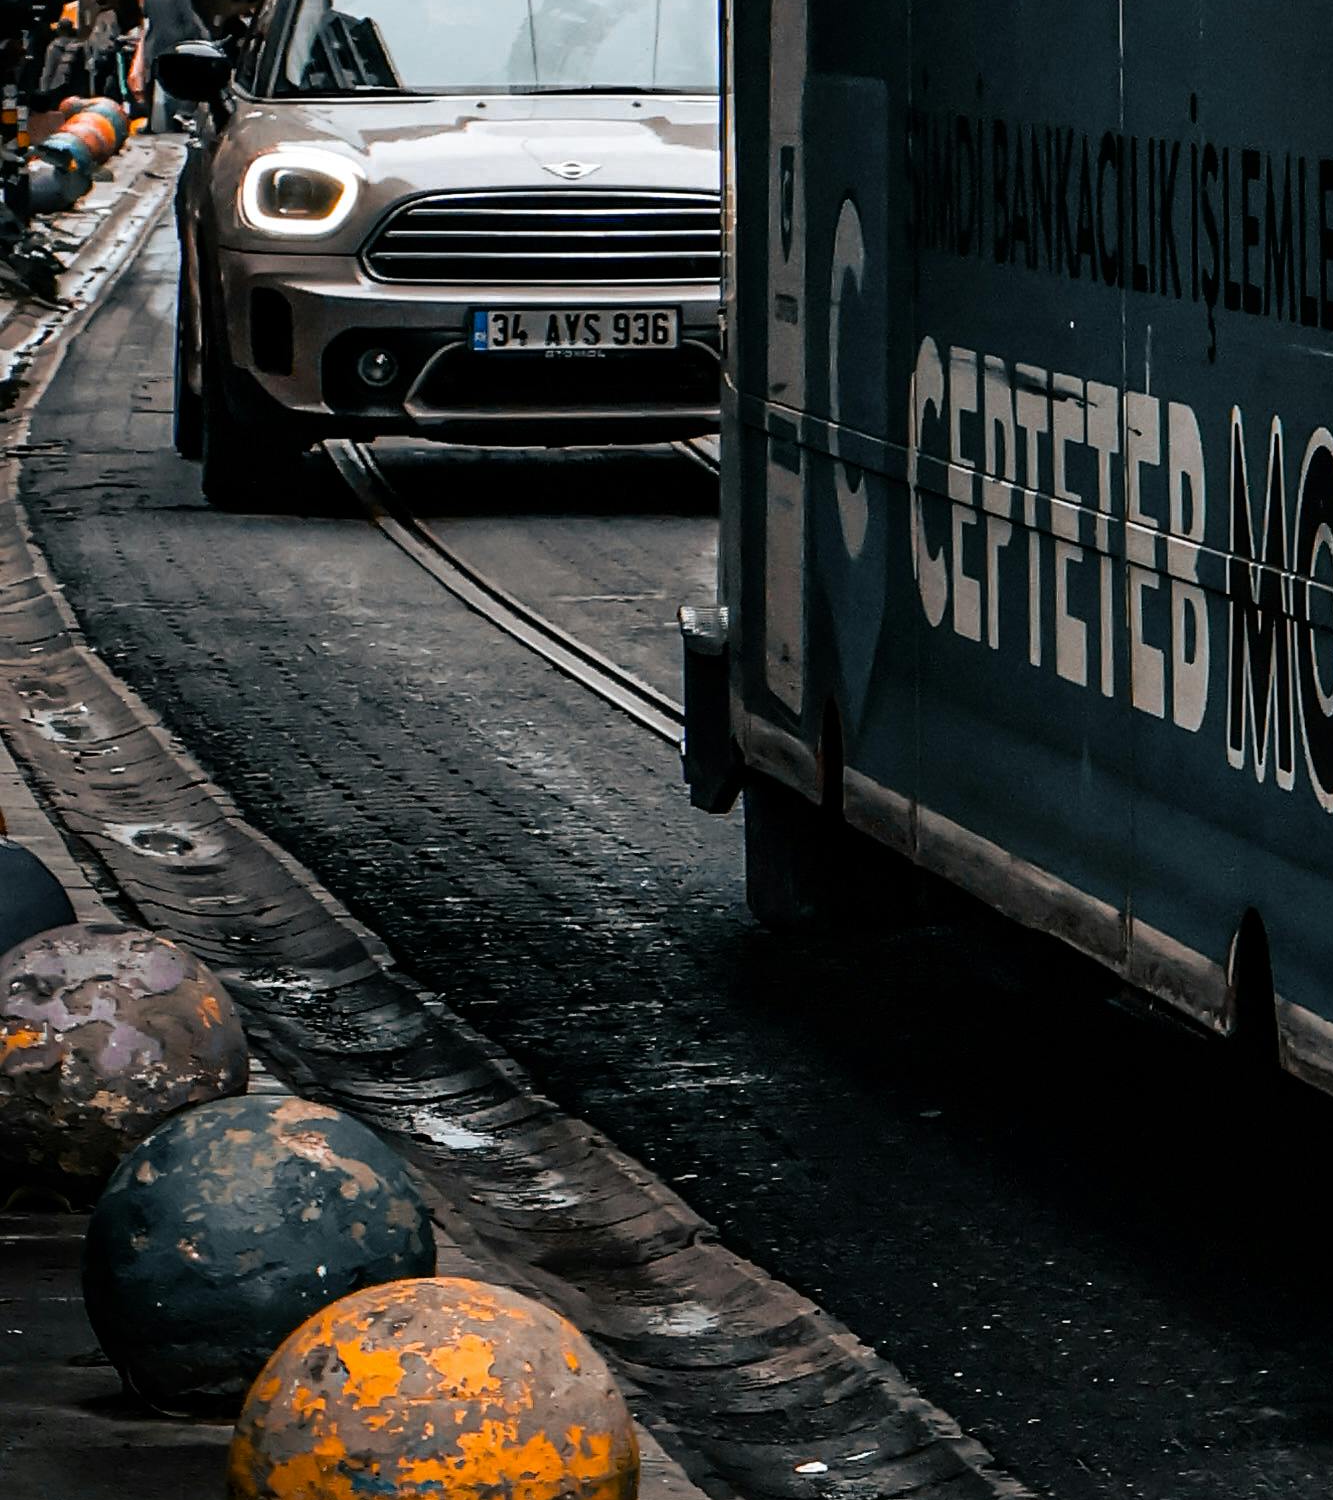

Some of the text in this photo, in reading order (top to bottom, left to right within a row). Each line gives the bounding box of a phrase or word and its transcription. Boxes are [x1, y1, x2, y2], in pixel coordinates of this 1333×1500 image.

[992, 116, 1182, 300] BANKACILIK
[492, 313, 669, 347] 34 AYS 936
[908, 335, 1210, 734] CEPTETEB
